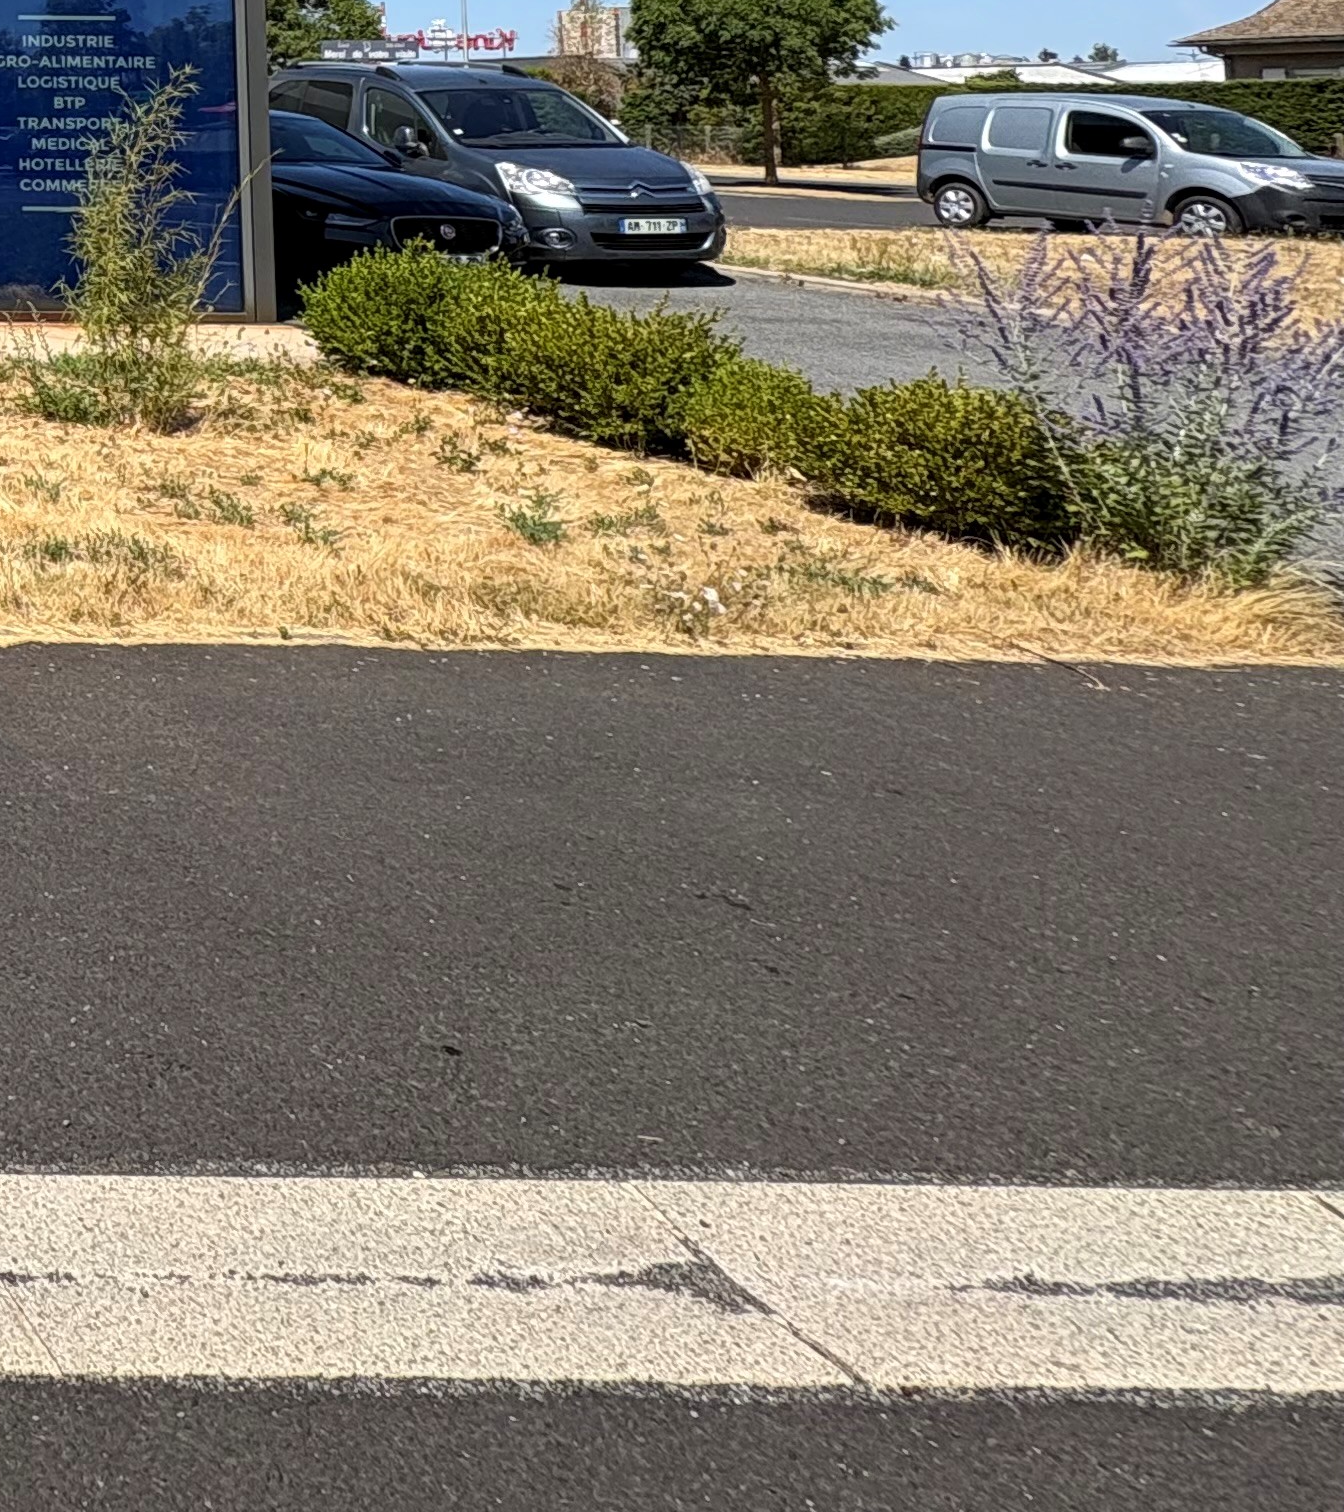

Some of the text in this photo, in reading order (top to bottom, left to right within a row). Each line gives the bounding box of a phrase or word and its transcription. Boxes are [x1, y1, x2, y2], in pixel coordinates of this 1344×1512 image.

[22, 35, 114, 48] INDUSTRIE
[17, 76, 120, 90] LOGISTIQUE
[54, 97, 86, 109] BTP
[16, 117, 123, 130] TRANSPORT
